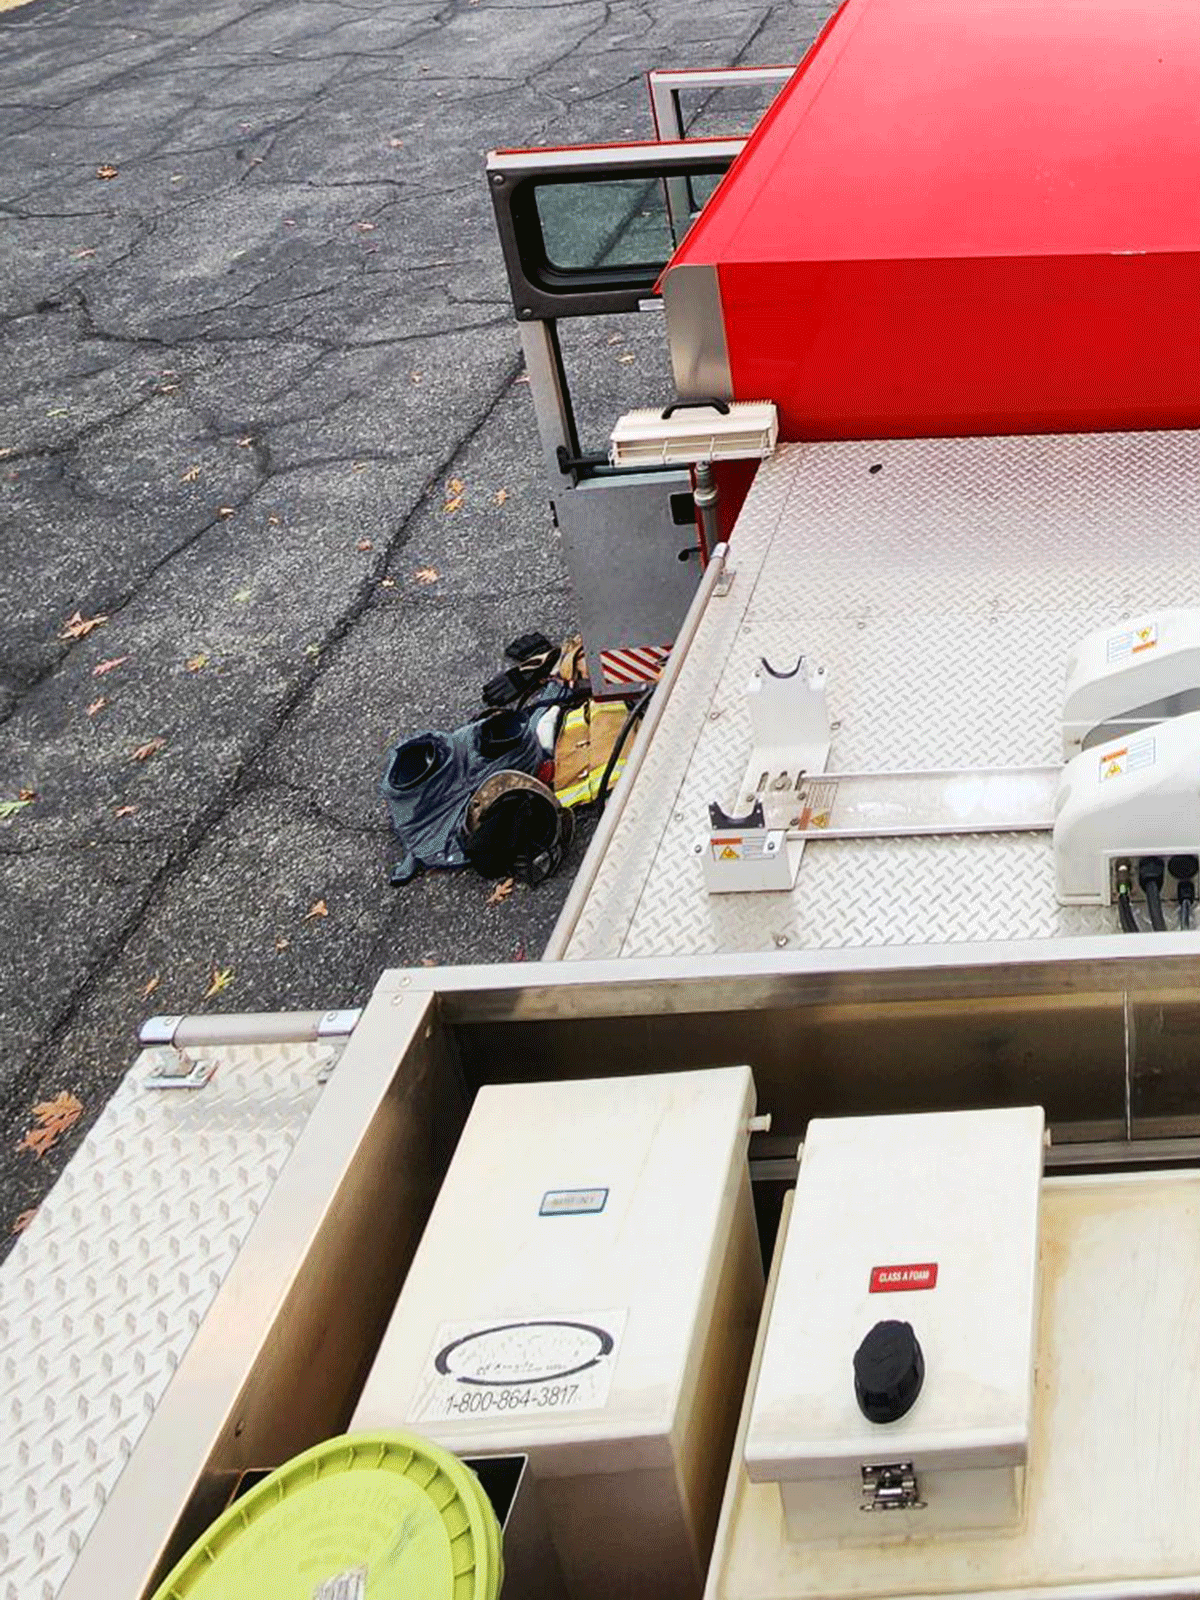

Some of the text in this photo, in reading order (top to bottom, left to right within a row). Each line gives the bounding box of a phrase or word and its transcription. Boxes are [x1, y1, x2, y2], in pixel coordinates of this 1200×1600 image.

[879, 1270, 901, 1283] CLASS
[909, 1269, 930, 1281] FOAM
[446, 1384, 580, 1415] 1-800-864-3817
